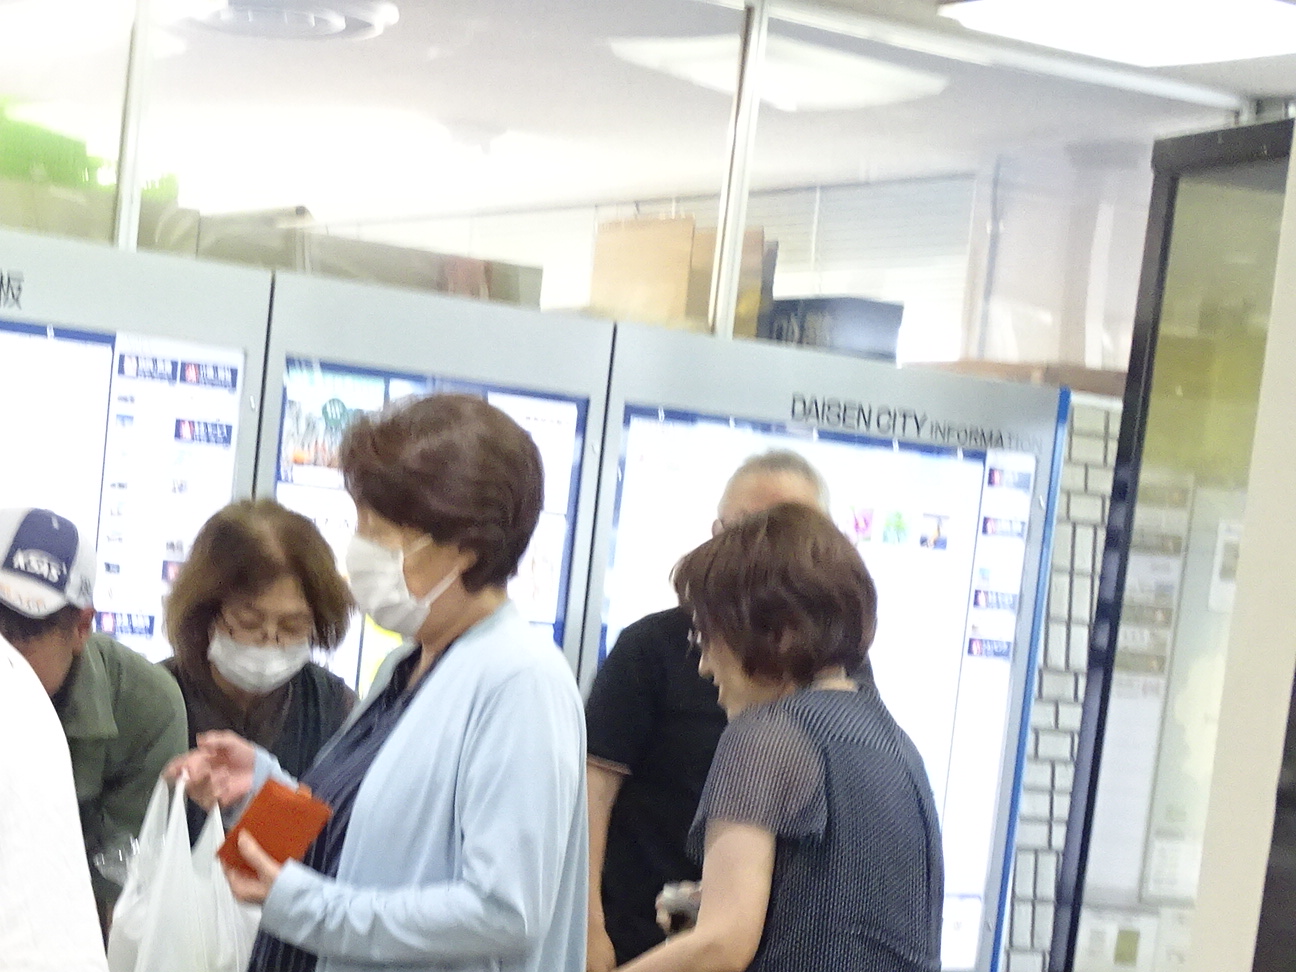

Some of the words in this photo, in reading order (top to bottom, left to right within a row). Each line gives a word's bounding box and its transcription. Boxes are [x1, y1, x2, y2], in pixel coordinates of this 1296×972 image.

[791, 391, 872, 432] DAISEN
[876, 404, 928, 438] CITY
[930, 419, 1043, 452] INFORMATION
